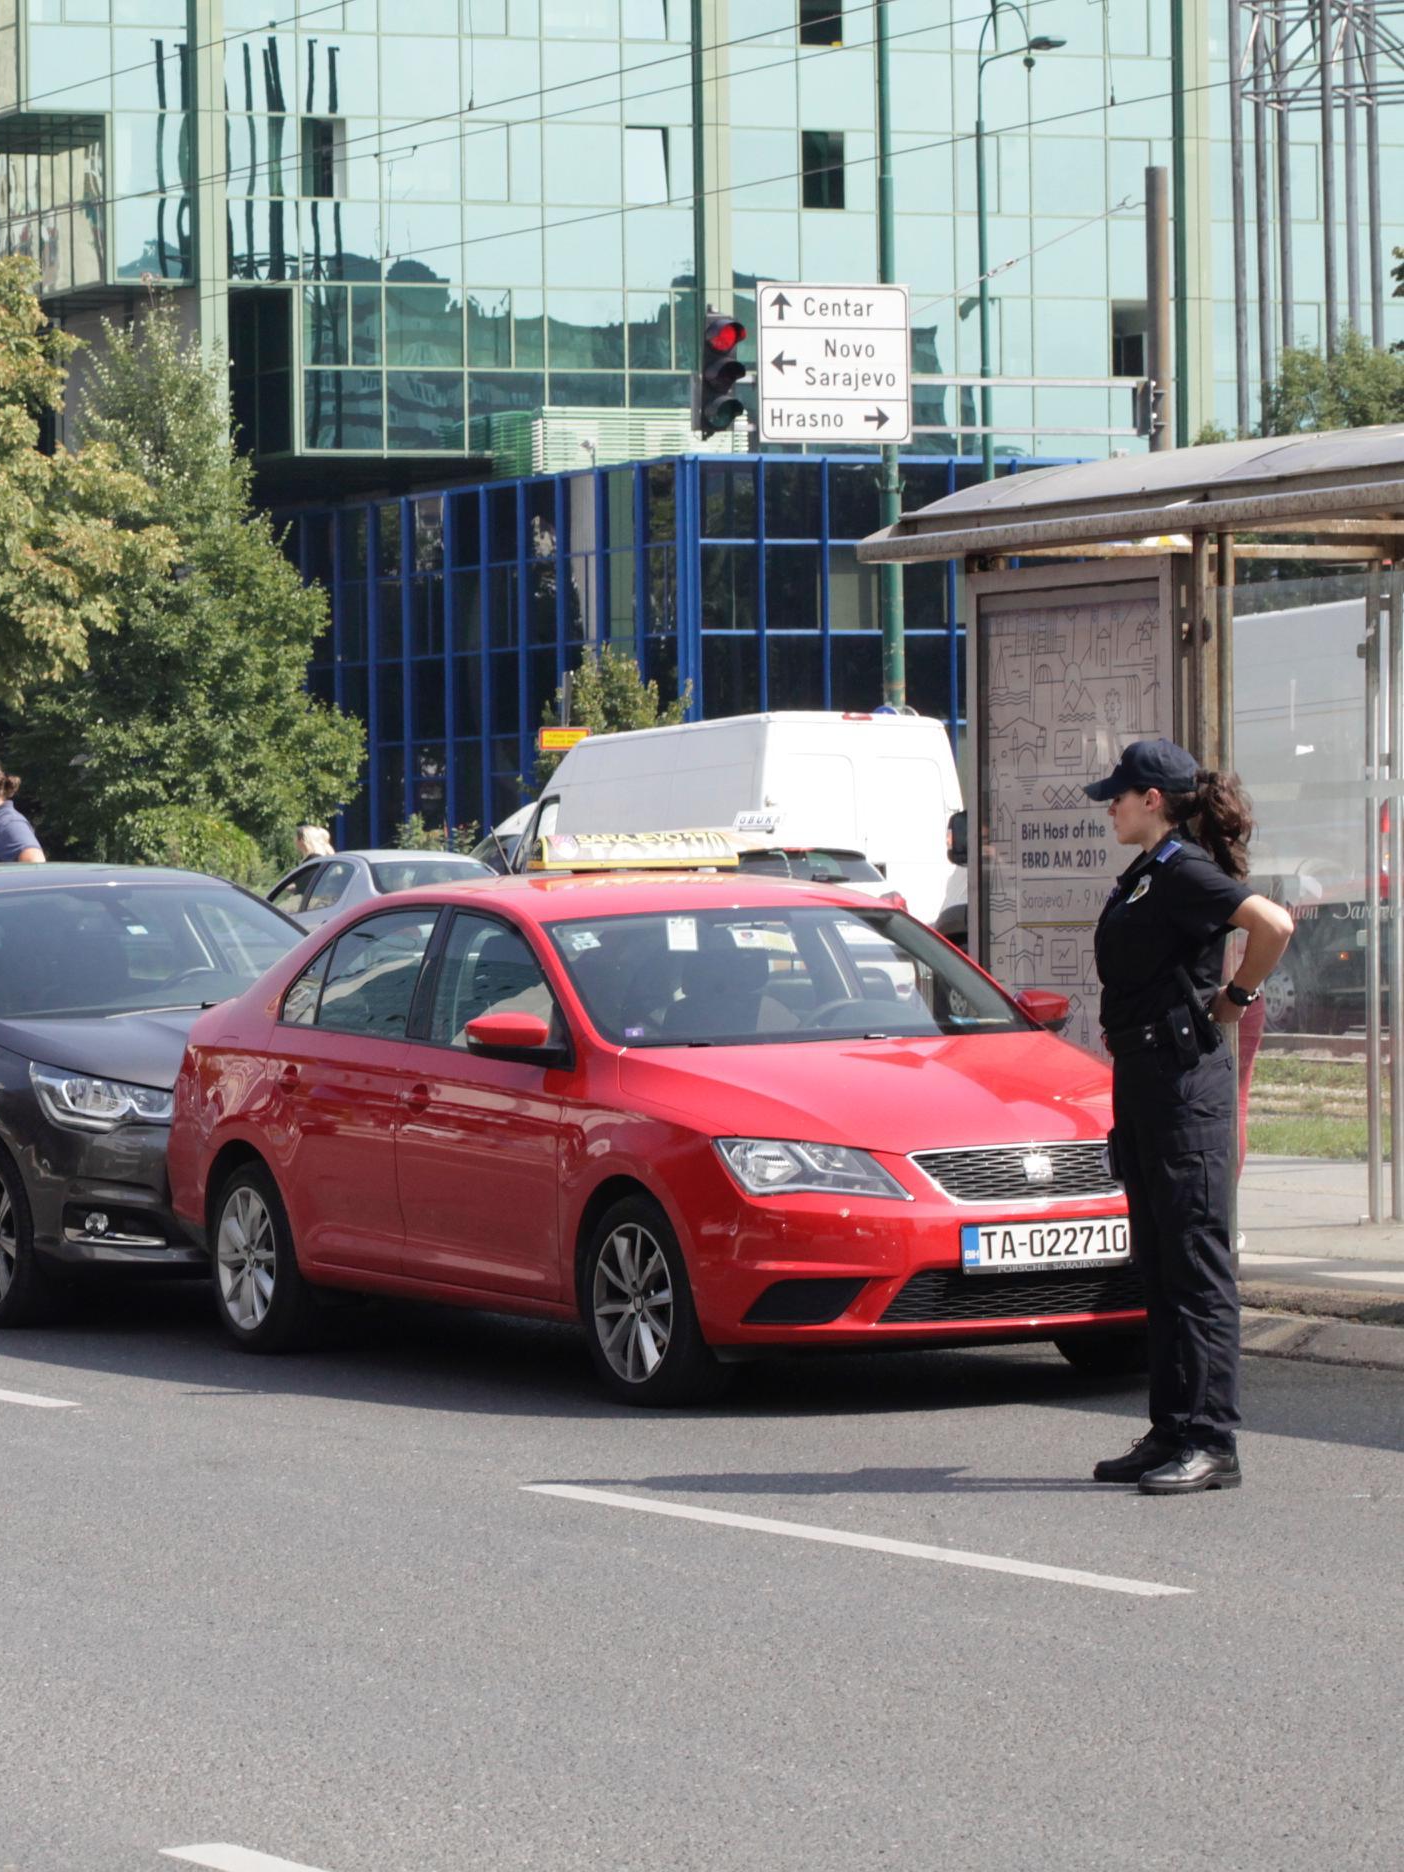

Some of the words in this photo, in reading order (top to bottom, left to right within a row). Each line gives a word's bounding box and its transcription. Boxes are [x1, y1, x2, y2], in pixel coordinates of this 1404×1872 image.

[804, 297, 874, 317] Centar
[824, 338, 875, 358] Novo
[804, 366, 896, 391] Sarajevo
[770, 408, 844, 427] Hrasno
[576, 832, 683, 843] SARAJEVO
[1021, 822, 1040, 841] BiH
[1043, 822, 1069, 840] Host
[1072, 819, 1086, 839] of
[1088, 819, 1106, 839] the
[1021, 851, 1050, 869] EBRD
[1053, 850, 1073, 868] AM
[1076, 849, 1107, 868] 2019
[1066, 889, 1073, 906] 7
[1084, 889, 1091, 908] 9
[980, 1224, 1128, 1260] TA-022710
[964, 1250, 980, 1260] BH
[997, 1261, 1046, 1273] PORSCHE
[1053, 1259, 1105, 1270] SARAJEVO
